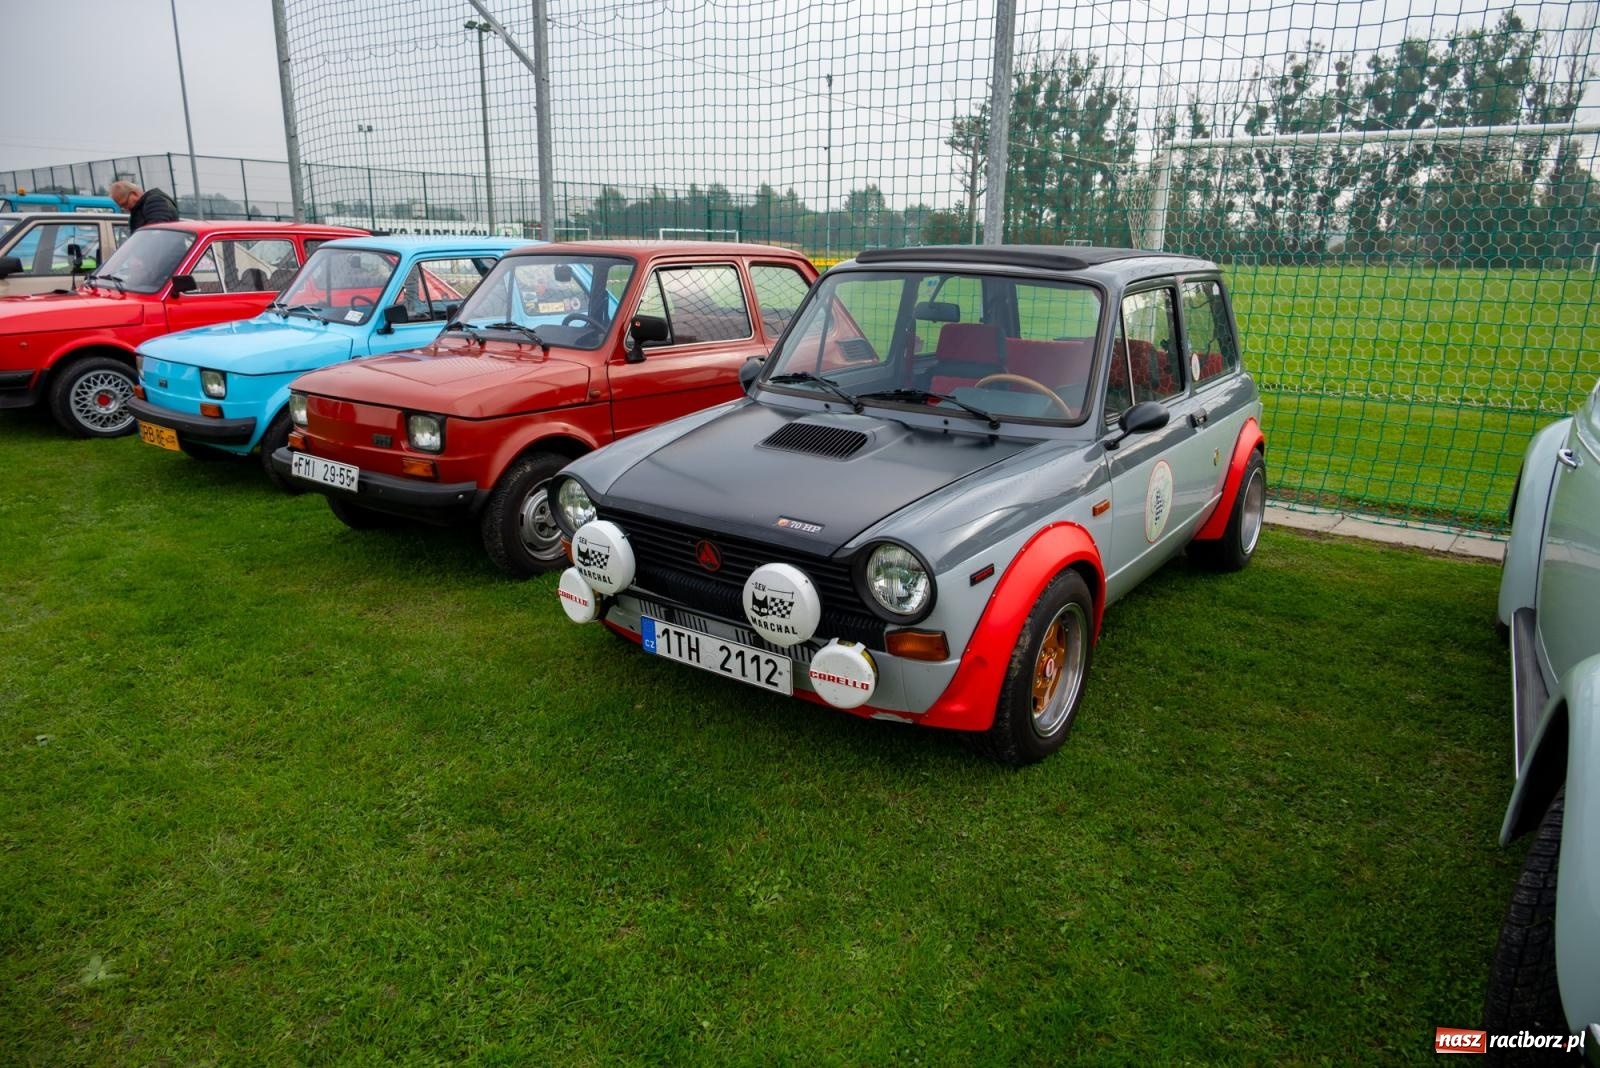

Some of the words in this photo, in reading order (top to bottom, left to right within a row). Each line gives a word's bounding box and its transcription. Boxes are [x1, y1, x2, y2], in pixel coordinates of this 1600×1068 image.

[297, 456, 316, 478] FMI
[322, 463, 353, 488] 29-55
[802, 523, 822, 533] HP
[577, 566, 614, 585] MARCHAL
[754, 581, 767, 592] SEV
[750, 615, 799, 635] MARCHAL
[644, 638, 656, 649] CZ
[661, 627, 701, 664] 1TH
[718, 644, 779, 687] 2112
[809, 670, 870, 691] CARELLO
